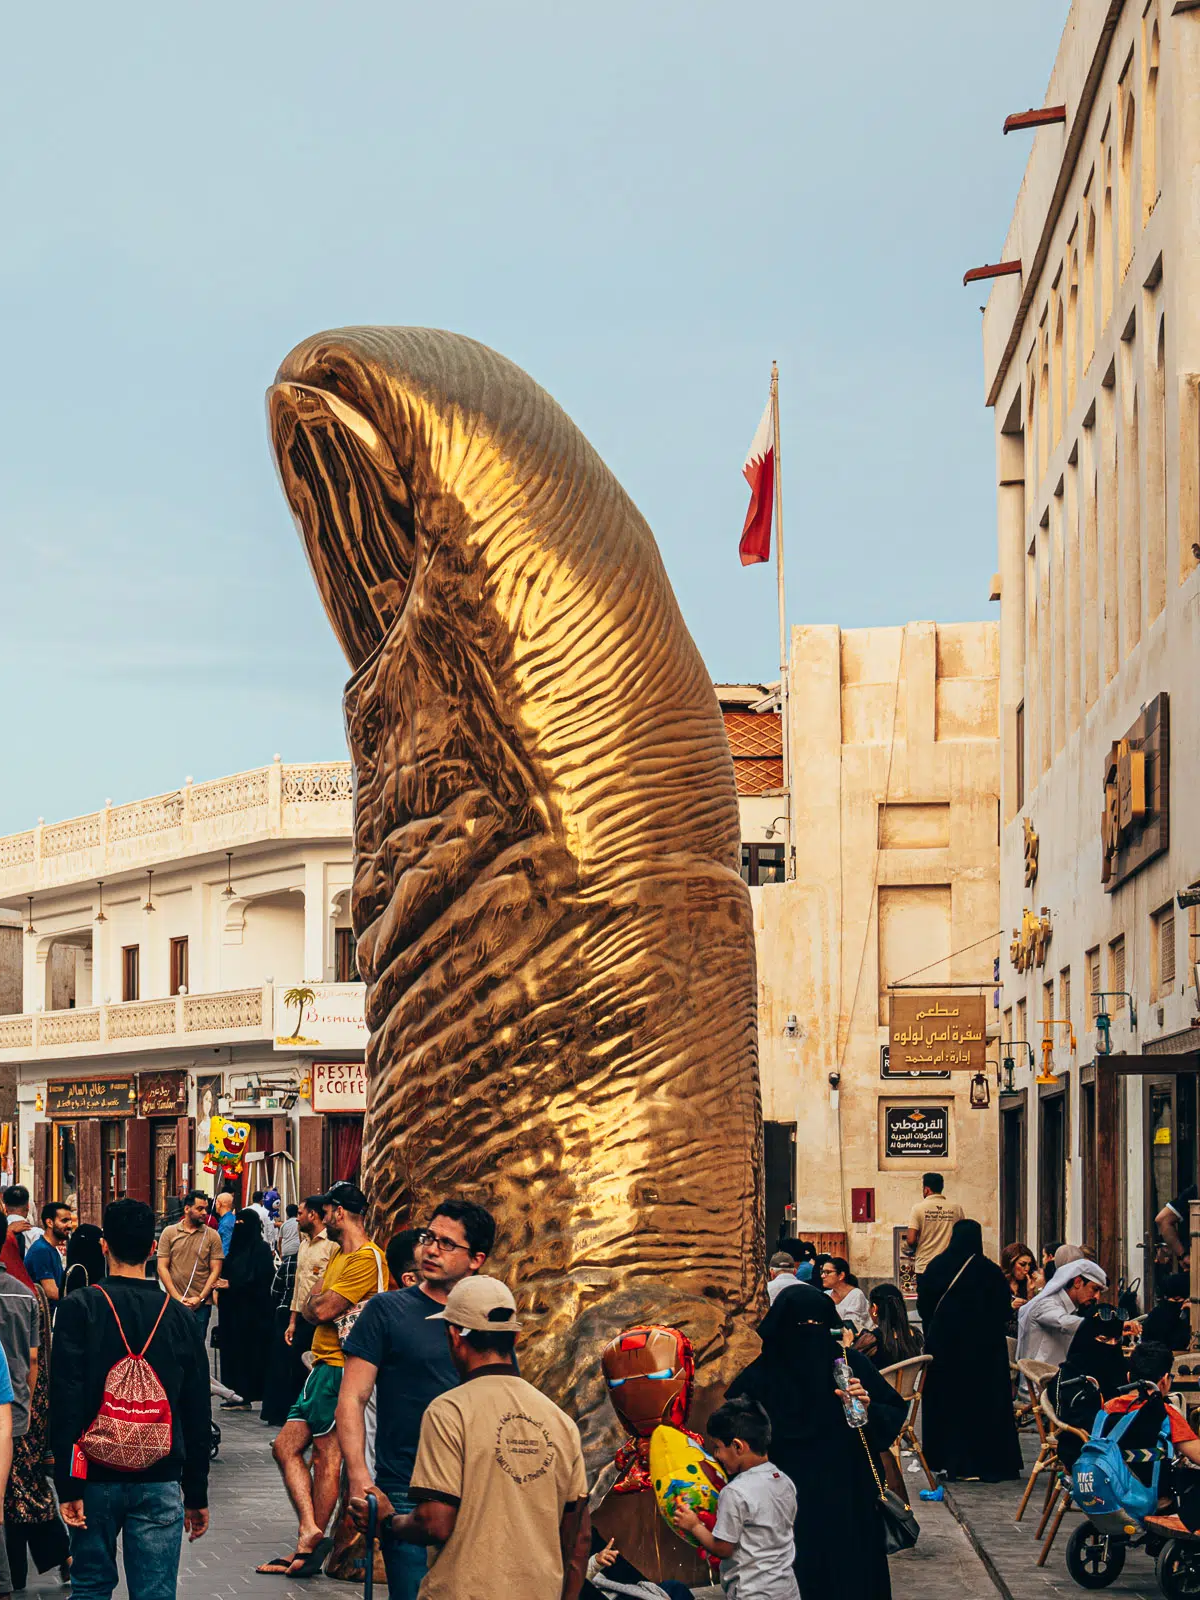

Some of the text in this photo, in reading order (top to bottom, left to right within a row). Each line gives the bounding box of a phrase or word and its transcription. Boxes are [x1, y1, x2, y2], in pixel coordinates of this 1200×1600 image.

[306, 1007, 364, 1022] BISMILLA
[916, 1002, 959, 1020] مطعم
[925, 1025, 950, 1048] امي
[952, 1024, 982, 1044] سفرة
[905, 1055, 933, 1063] محمد
[317, 1065, 366, 1079] RESTA
[326, 1081, 365, 1093] COFFE
[890, 1119, 943, 1131] القرموطي
[914, 1131, 943, 1140] للمأكولات
[1077, 1472, 1094, 1483] NICE
[1079, 1482, 1094, 1493] DAY
